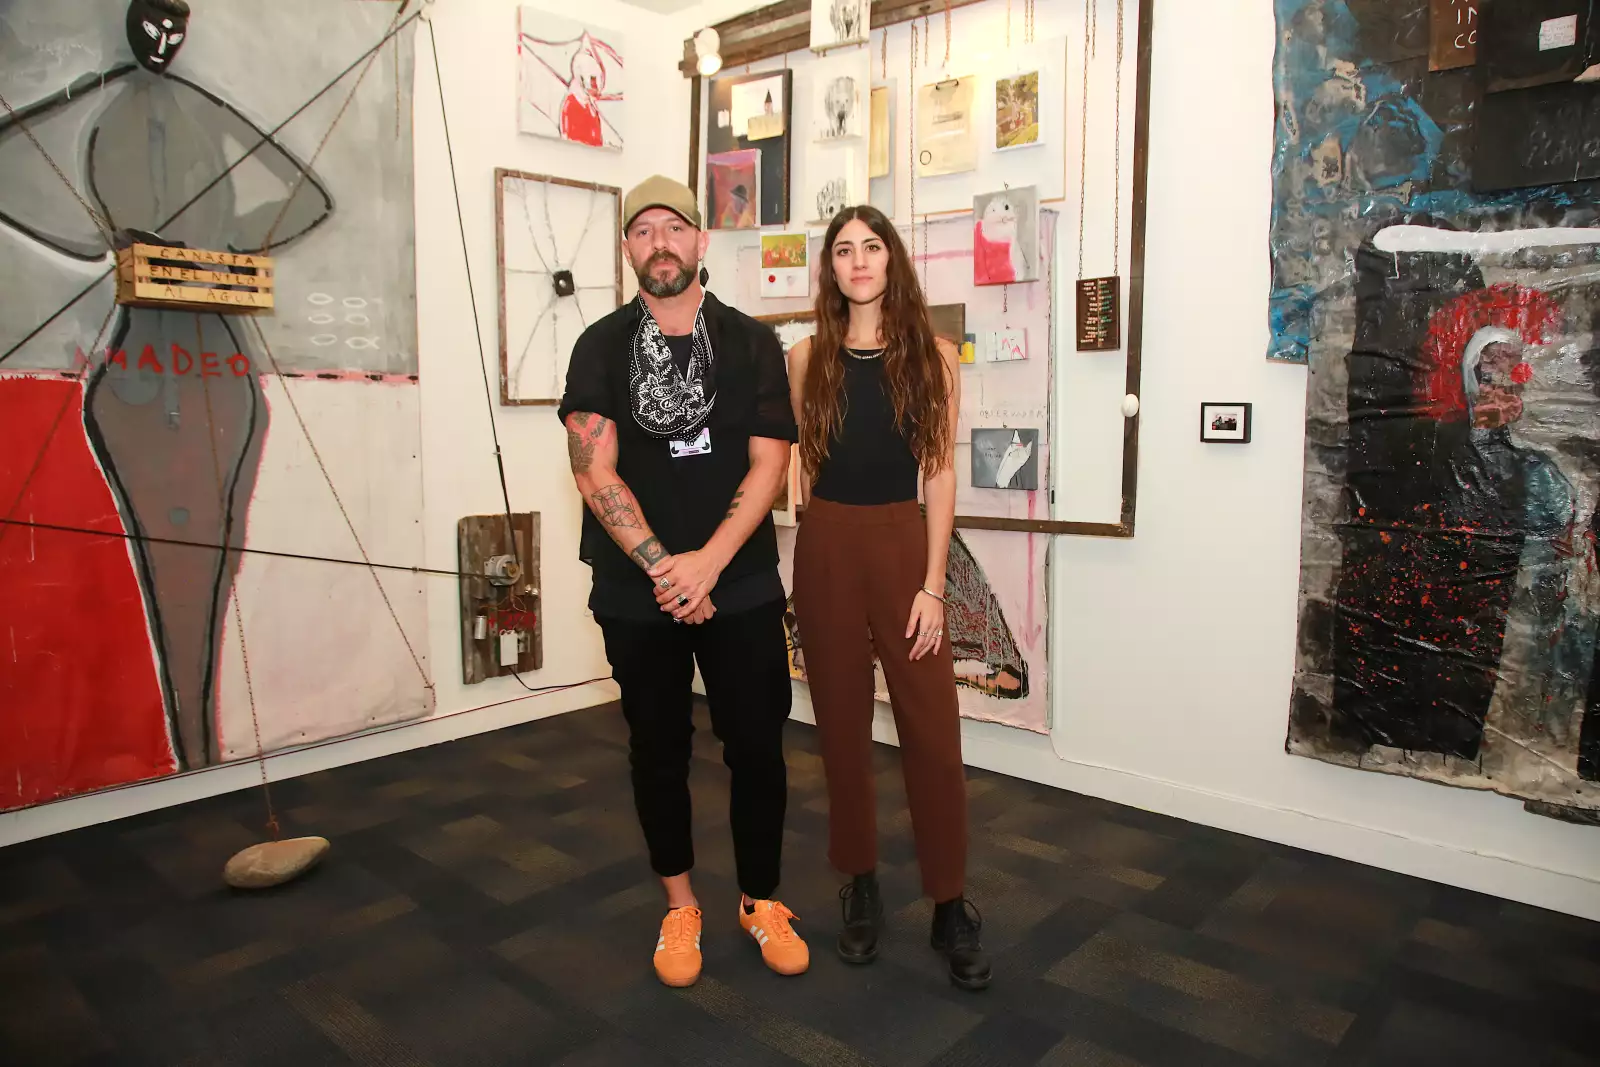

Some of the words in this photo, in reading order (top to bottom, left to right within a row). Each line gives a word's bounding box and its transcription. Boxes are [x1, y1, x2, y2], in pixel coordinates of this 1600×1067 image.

[160, 249, 255, 266] CANASTA
[150, 266, 173, 277] EN
[180, 268, 200, 278] EL
[206, 289, 256, 304] AGUA
